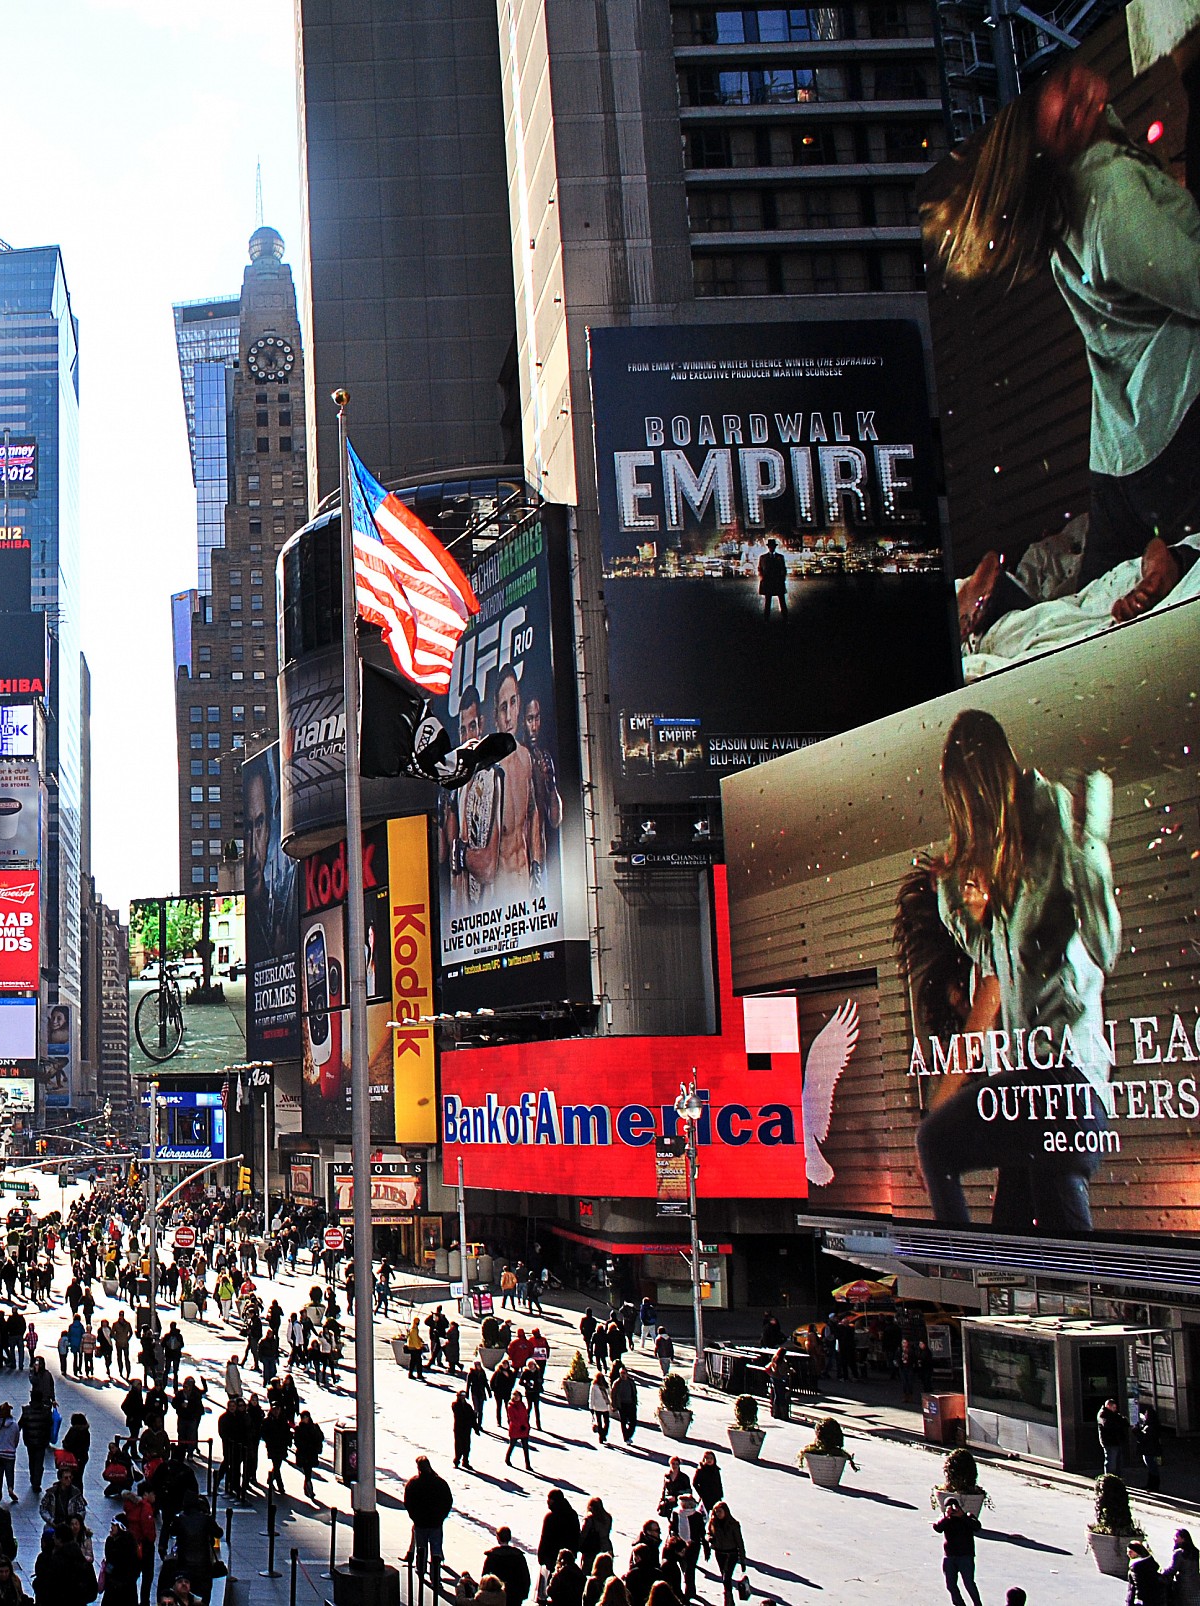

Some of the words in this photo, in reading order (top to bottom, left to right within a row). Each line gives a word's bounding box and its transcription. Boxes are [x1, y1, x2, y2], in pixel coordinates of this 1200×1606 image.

[627, 362, 650, 372] FROM
[719, 360, 748, 369] WRITER
[751, 359, 783, 369] TERENCE
[784, 358, 815, 368] WINTER
[670, 371, 688, 381] AND
[689, 370, 730, 380] EXECUTIVE
[731, 368, 770, 379] PRODUCER
[773, 367, 803, 378] MARTIN
[805, 366, 843, 377] SCORSESE
[644, 410, 879, 447] BOARDWALK
[1, 467, 34, 482] 2012
[614, 443, 922, 533] EMPIRE
[499, 521, 542, 580] MENDES
[505, 566, 537, 607] JOHNSON
[513, 626, 533, 658] RIO
[659, 730, 697, 742] EMPIRE
[709, 738, 747, 751] SEASON
[750, 738, 770, 750] ONE
[304, 841, 377, 910] Kodk
[451, 907, 501, 935] SATURDAY
[504, 900, 530, 921] JAN.
[532, 896, 547, 913] 14
[443, 932, 464, 953] LIVE
[466, 929, 480, 948] ON
[482, 911, 559, 944] PAY-PER-VIEW
[254, 962, 296, 987] SHERLOCK
[393, 903, 429, 1058] Kodak
[255, 984, 296, 1012] HOLMES
[907, 1020, 1117, 1077] AMERICAN
[1130, 1014, 1200, 1064] EA
[977, 1079, 1200, 1121] OUTFITTERS
[1043, 1130, 1121, 1153] ae.com
[334, 1165, 421, 1173] MAQUIS
[1124, 1286, 1185, 1301] AMERICAN
